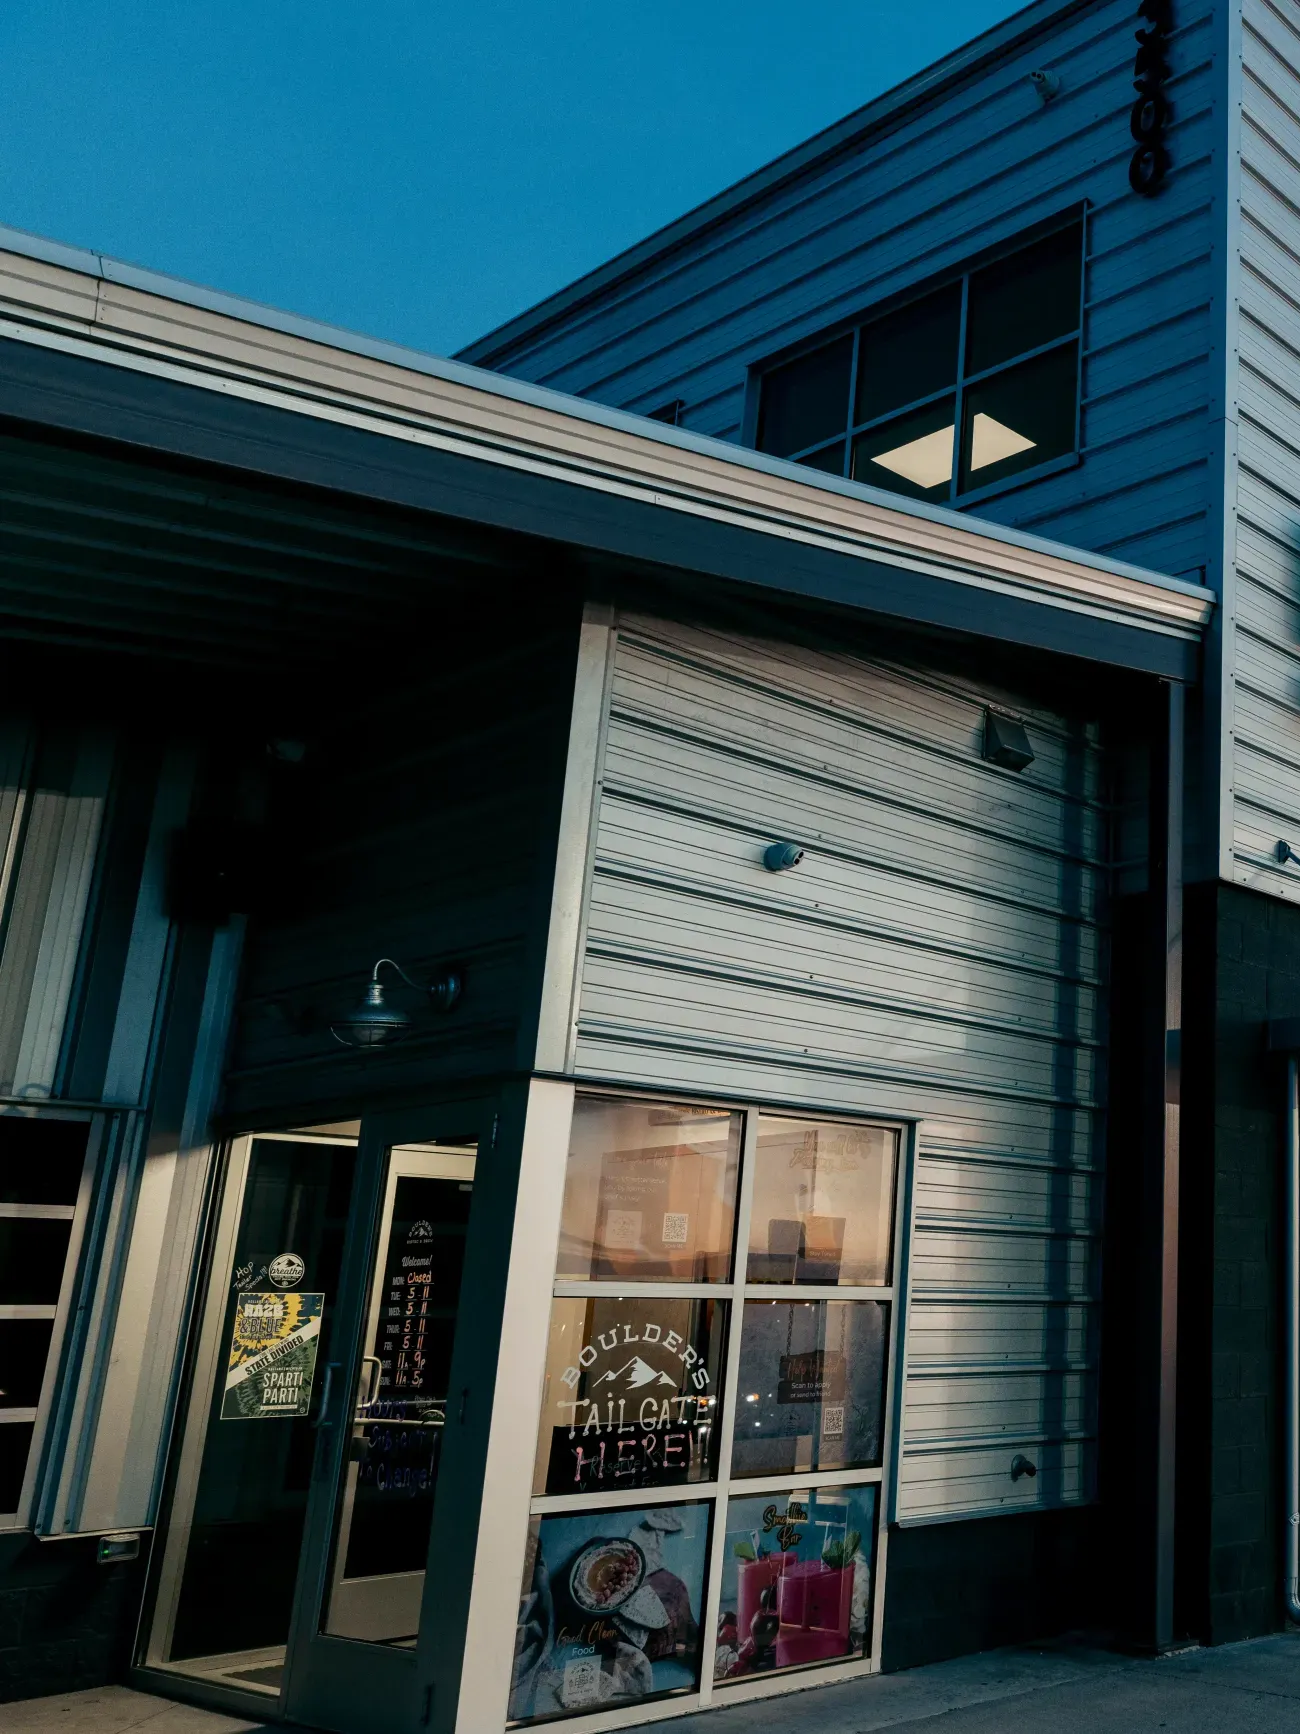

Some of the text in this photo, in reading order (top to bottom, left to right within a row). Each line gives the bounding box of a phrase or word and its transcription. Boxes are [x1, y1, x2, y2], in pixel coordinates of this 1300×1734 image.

[407, 1270, 432, 1283] Closed
[407, 1287, 416, 1299] 5
[405, 1302, 414, 1315] 5
[404, 1319, 411, 1332] 5
[402, 1335, 410, 1349] 5
[245, 1352, 275, 1376] STATE
[271, 1335, 304, 1365] DIVIDED
[560, 1323, 710, 1390] BOULDER'S
[262, 1371, 304, 1388] SPARTI
[262, 1386, 299, 1404] PARTI
[572, 1645, 596, 1657] Food
